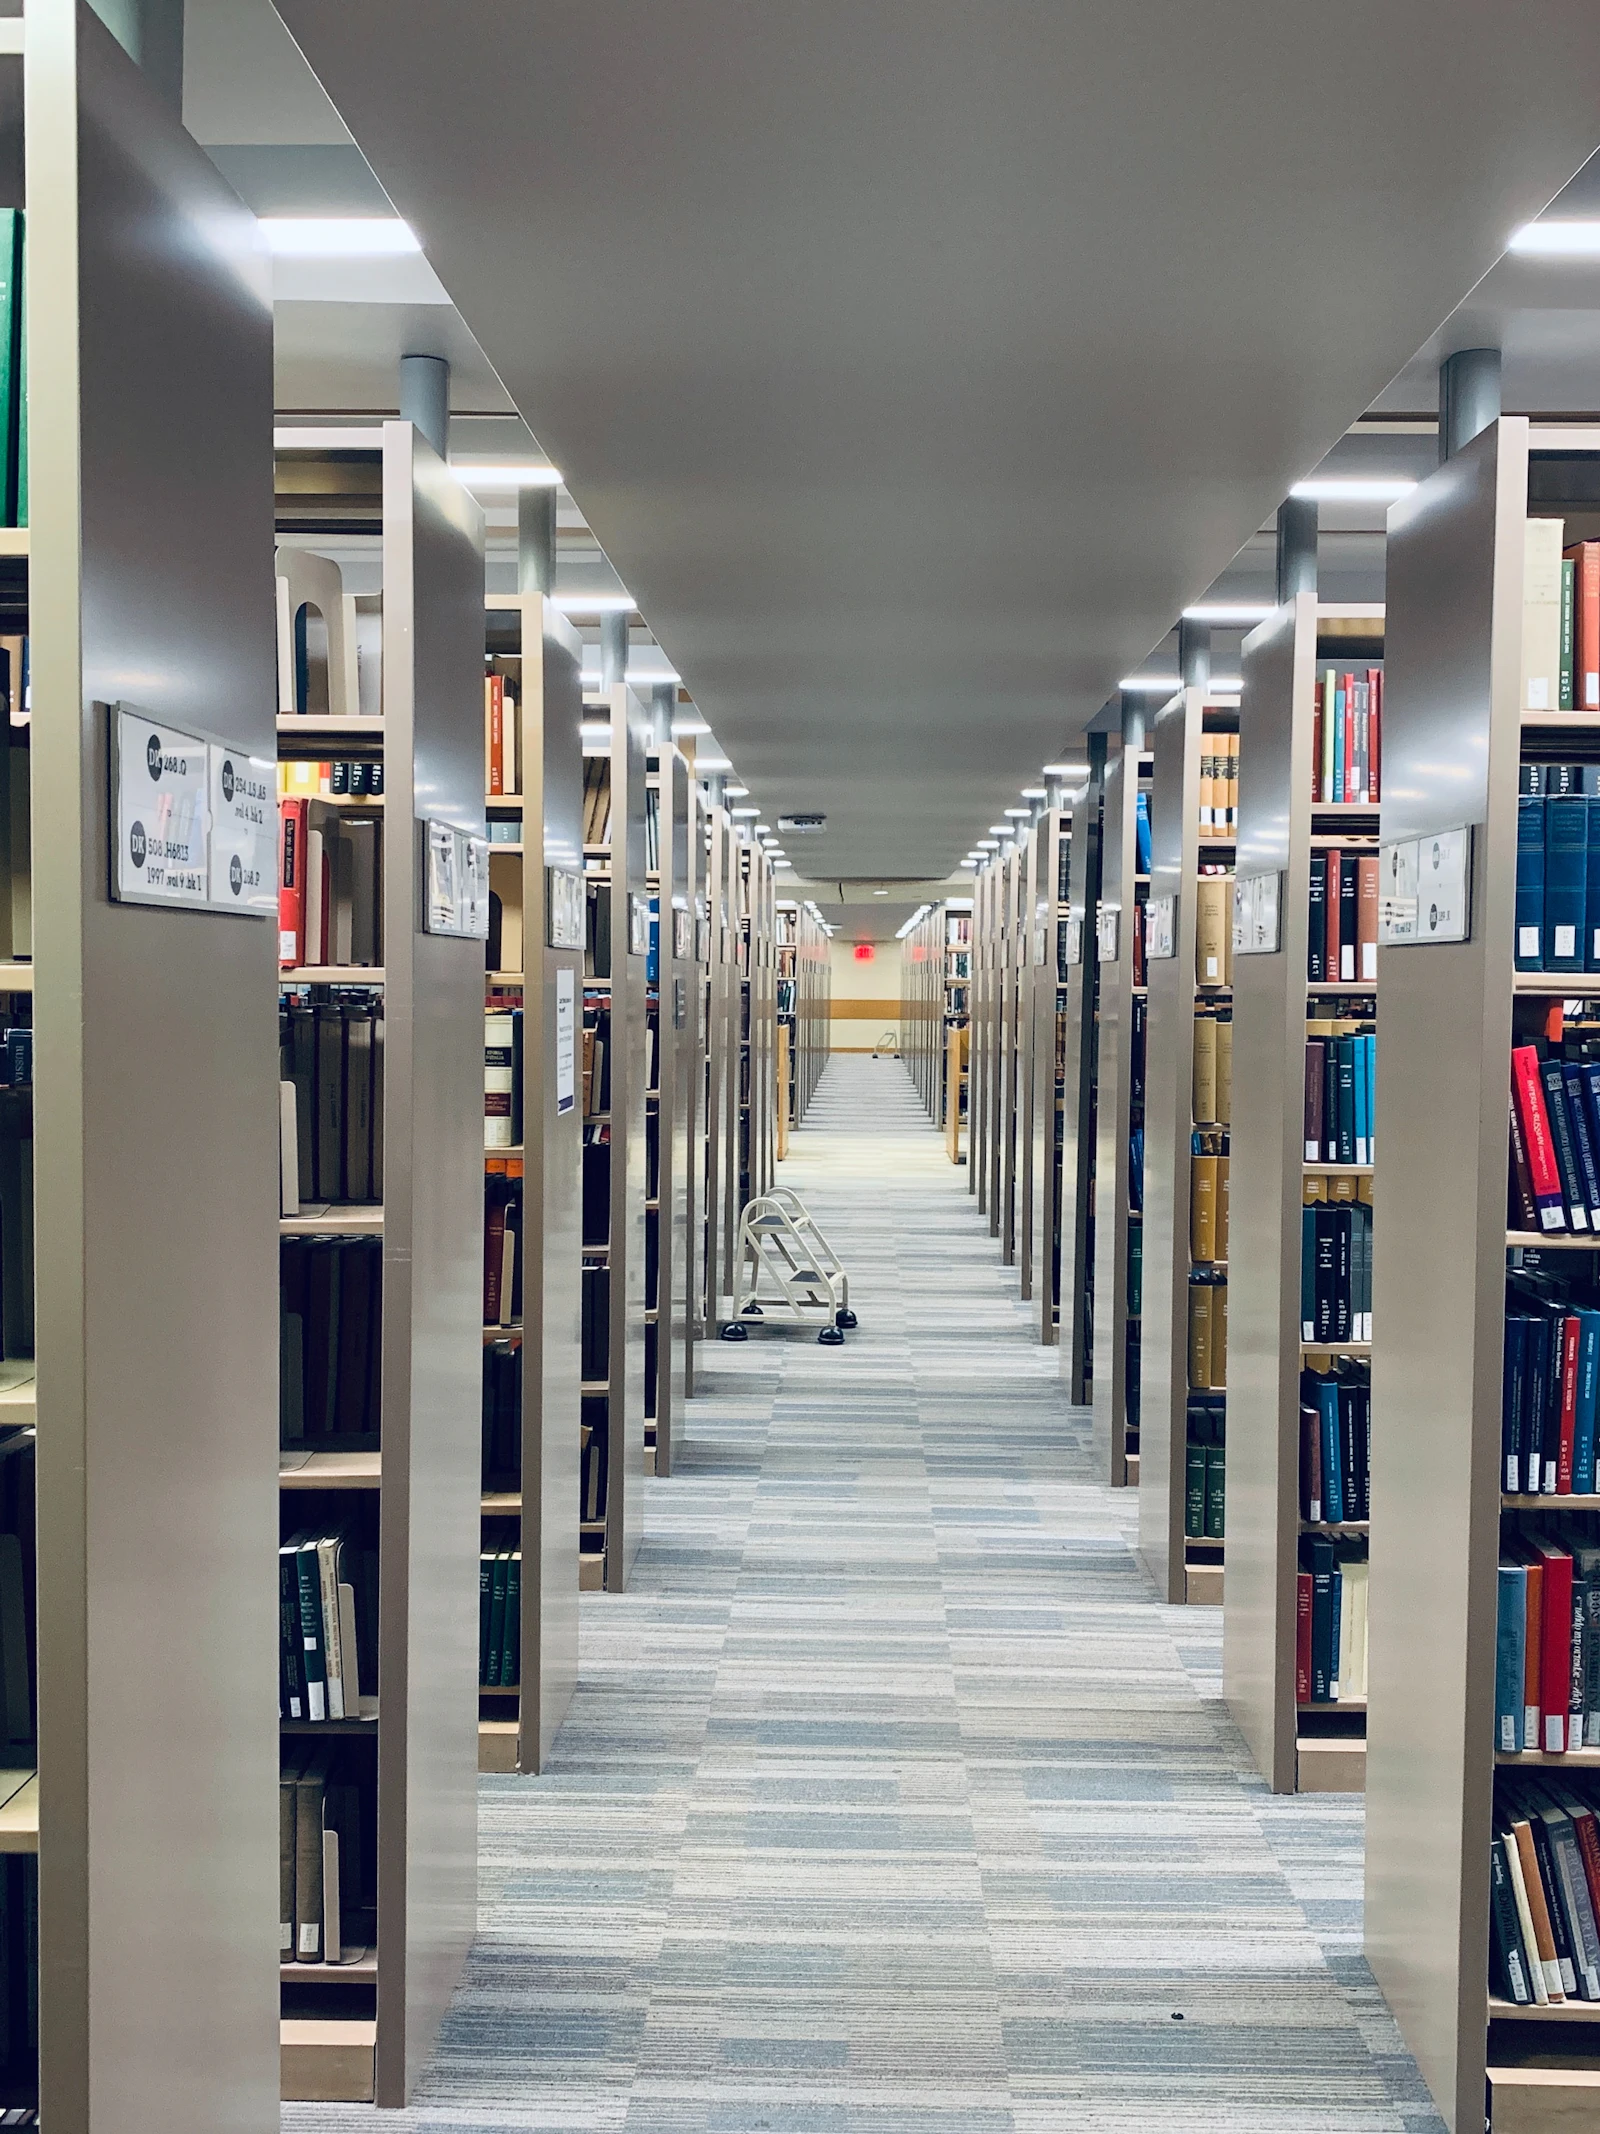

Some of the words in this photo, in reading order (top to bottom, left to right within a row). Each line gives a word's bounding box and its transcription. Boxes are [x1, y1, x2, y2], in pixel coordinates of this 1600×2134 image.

[148, 748, 161, 768] DK
[164, 754, 178, 773] 268
[223, 772, 234, 790] DK
[132, 834, 144, 854] DK
[148, 838, 162, 856] 508
[147, 866, 164, 884] 1997
[231, 866, 242, 883] DK
[15, 1045, 24, 1082] RUSSIA
[1565, 1839, 1587, 1904] PERSIAN
